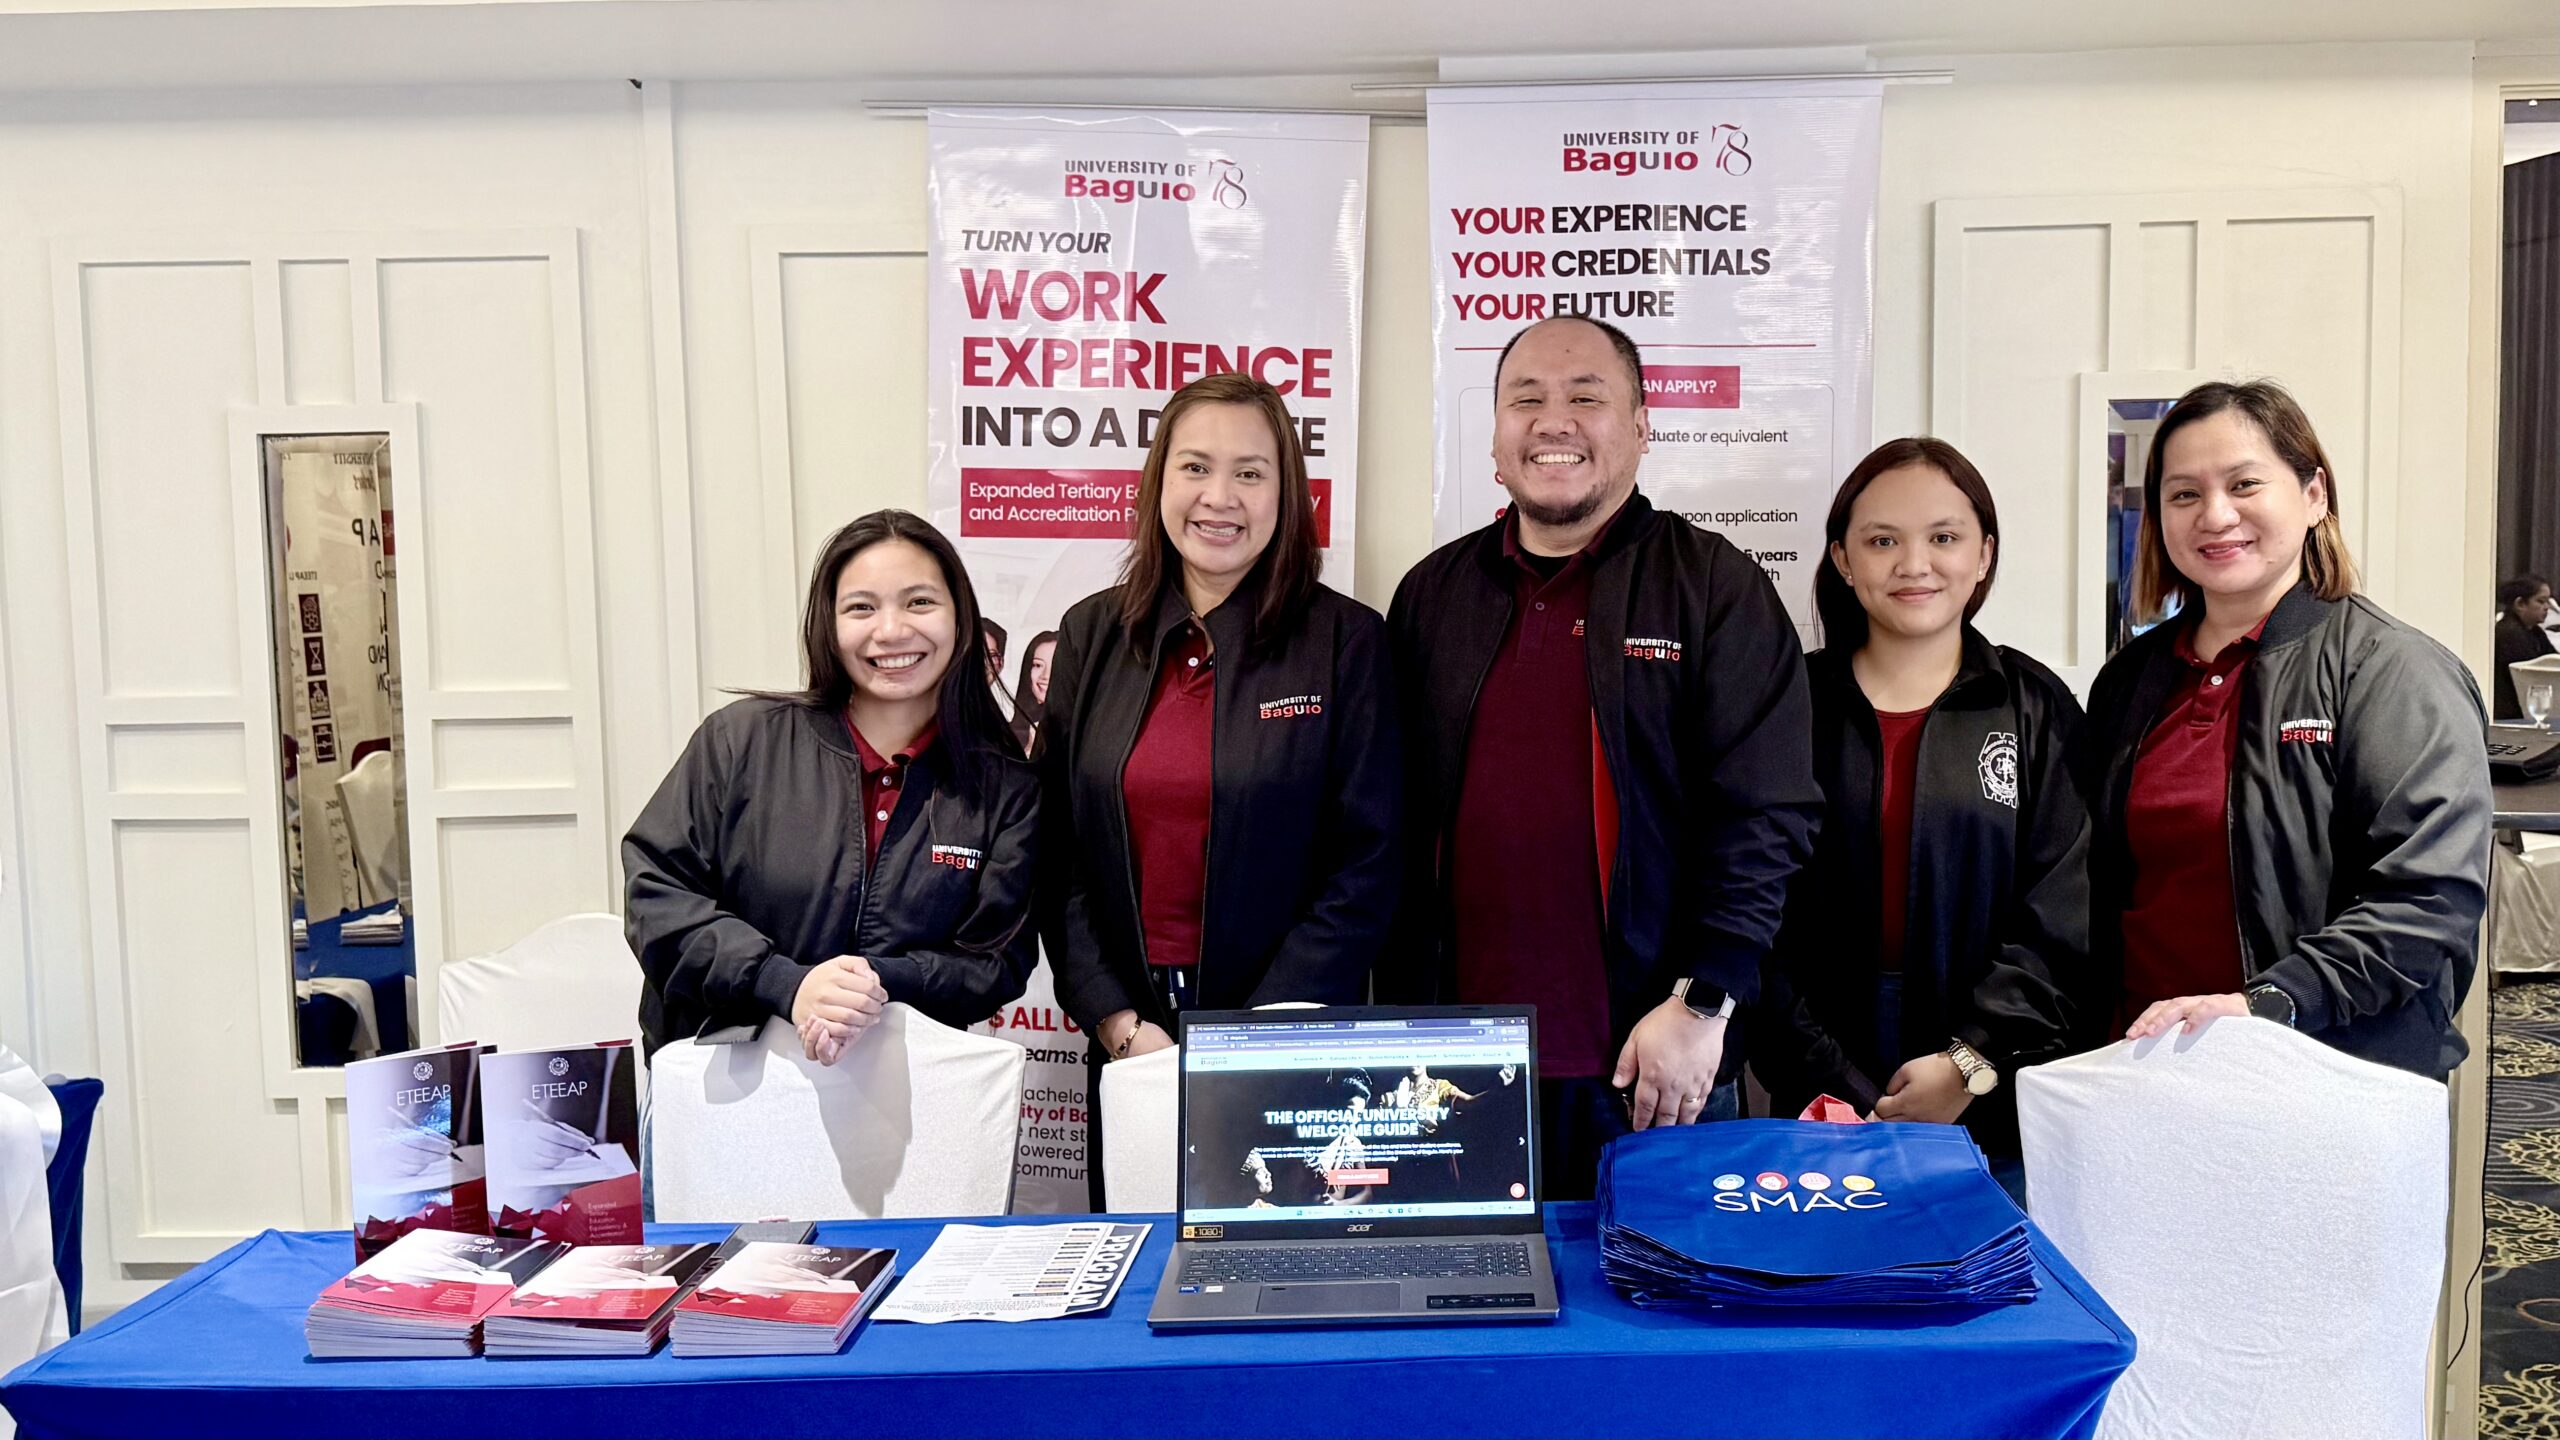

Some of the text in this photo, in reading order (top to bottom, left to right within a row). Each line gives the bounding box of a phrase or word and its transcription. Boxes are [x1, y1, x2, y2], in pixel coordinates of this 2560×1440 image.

[1563, 131, 1699, 146] UNIVERSITY OF
[1065, 160, 1197, 177] UNIVERSITY OF
[1563, 148, 1698, 177] Baguio
[1065, 174, 1196, 204] Baguio
[1451, 204, 1747, 235] YOUR EXPERIENCE
[961, 230, 1112, 254] TURN YOUR
[1452, 248, 1771, 278] YOUR CREDENTIALS
[960, 269, 1168, 324] WORK
[1452, 290, 1675, 321] YOUR FUTURE
[1642, 379, 1718, 394] AN APPLY?
[962, 406, 1081, 448] INTO
[1089, 408, 1127, 448] A
[1648, 429, 1789, 446] duate or equivalent
[969, 483, 1055, 502] Expanded
[1058, 483, 1122, 504] Tertiary
[969, 505, 1004, 521] and
[1007, 505, 1121, 522] Accreditation
[1715, 509, 1798, 526] application
[1755, 551, 1798, 565] years
[1260, 695, 1322, 710] UNIVERSITY OF
[1261, 704, 1322, 720] Baguio
[2281, 729, 2332, 743] Bagui
[932, 851, 980, 870] Bagui
[1010, 1006, 1058, 1032] ALL
[1026, 1048, 1078, 1065] eams
[396, 1084, 451, 1107] ETEEAP
[532, 1081, 588, 1100] ETEEAP
[1024, 1086, 1087, 1104] achelo
[1048, 1106, 1065, 1121] of
[1264, 1107, 1450, 1125] THE OFFICIAL UNIVERSITY
[1029, 1126, 1065, 1141] next
[1070, 1128, 1086, 1142] st
[1297, 1123, 1419, 1138] WELCOME GUIDE
[1020, 1145, 1084, 1161] owered
[1713, 1191, 1888, 1213] SMAC
[1346, 1223, 1374, 1233] acer
[1070, 1233, 1135, 1308] PROGRAM
